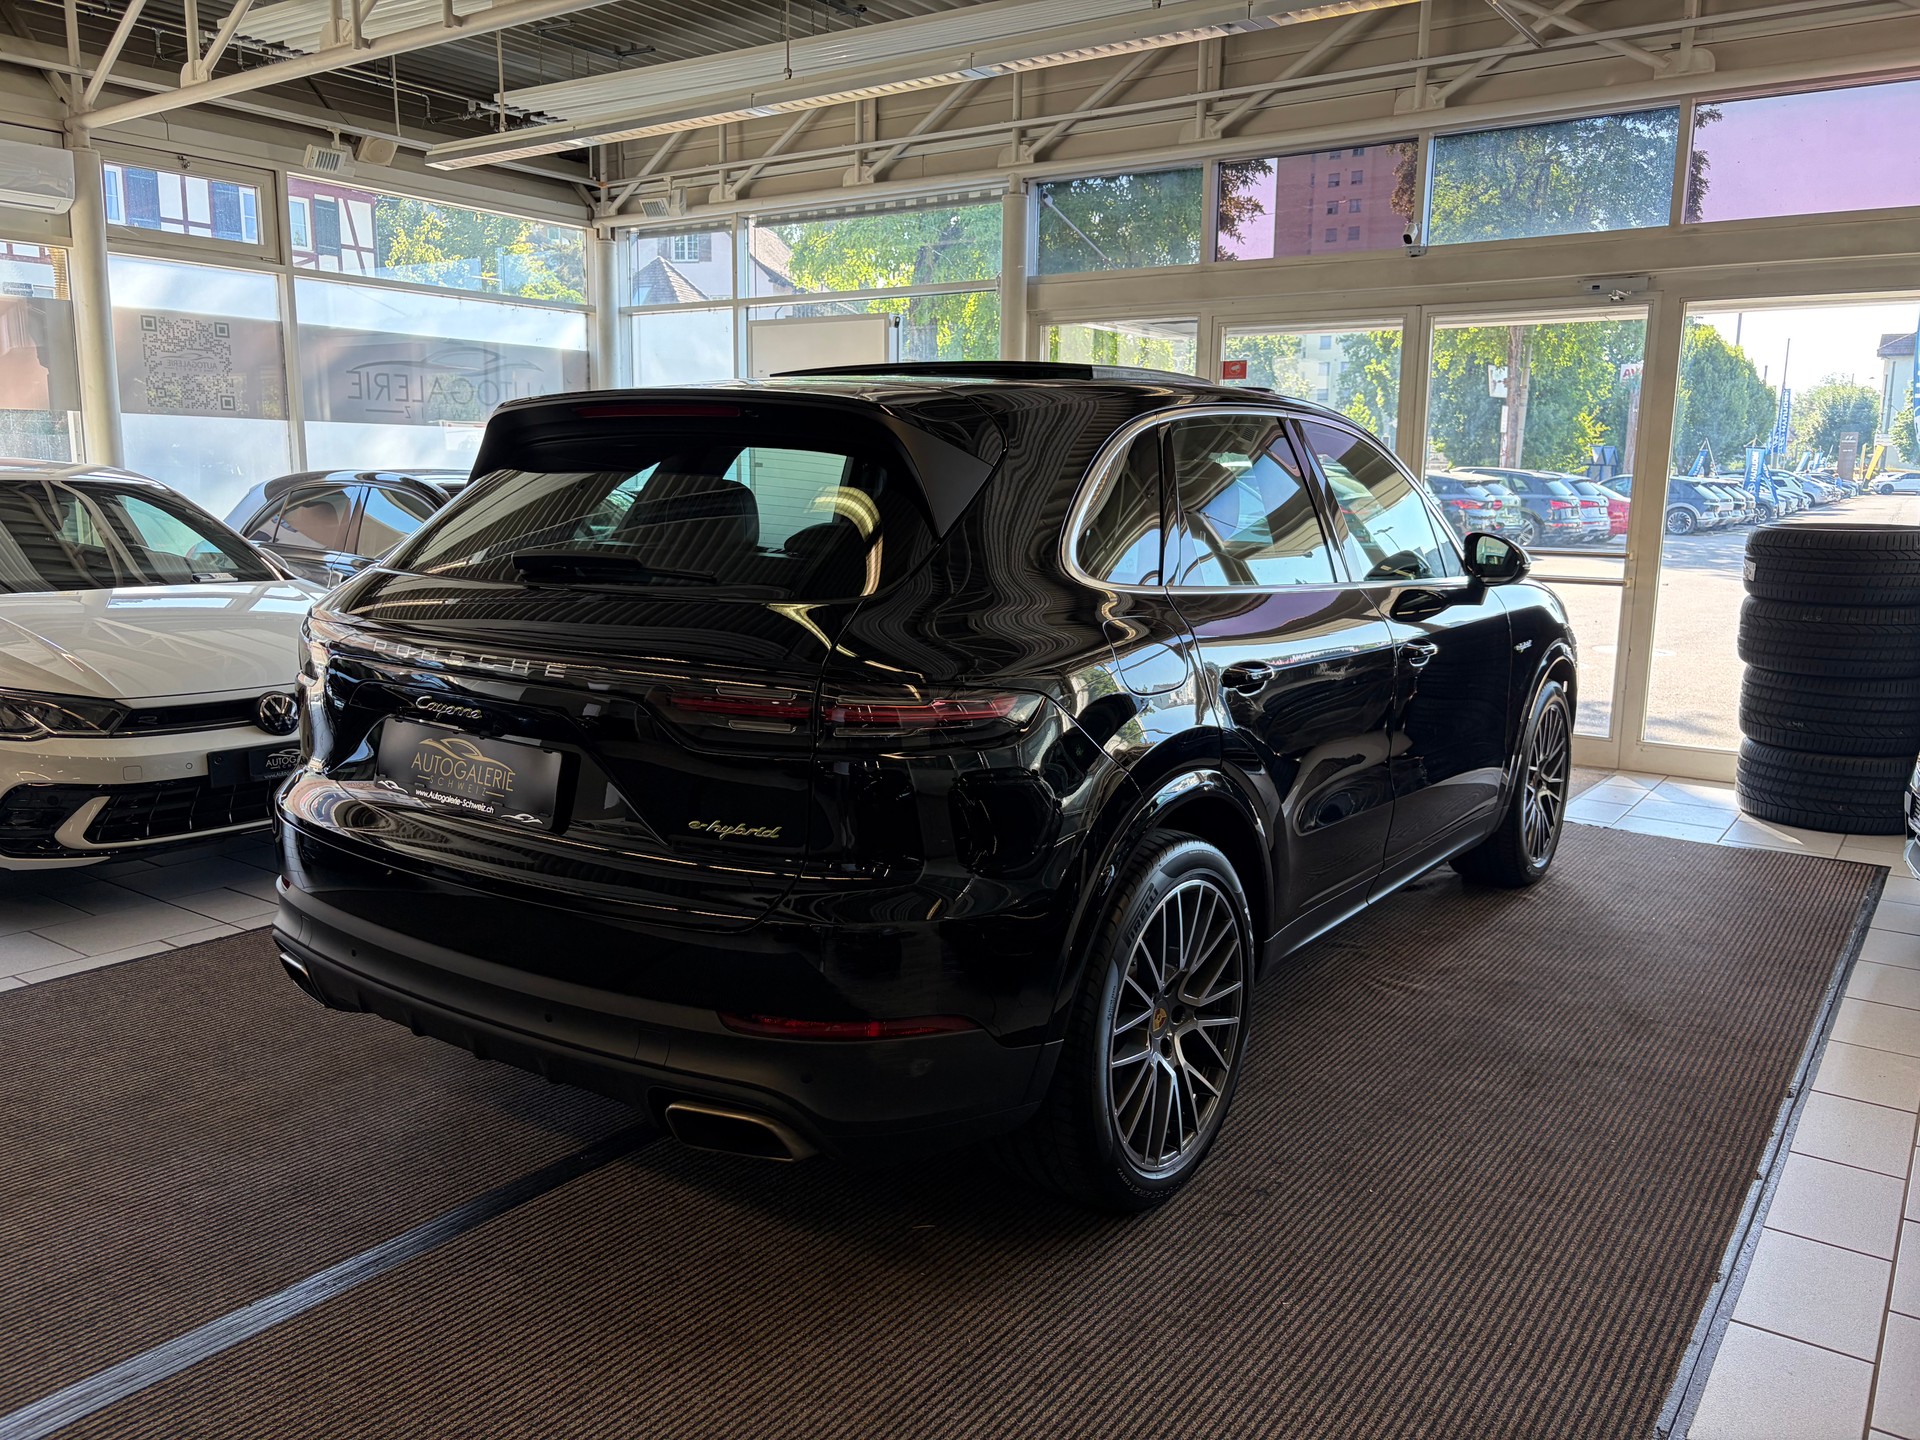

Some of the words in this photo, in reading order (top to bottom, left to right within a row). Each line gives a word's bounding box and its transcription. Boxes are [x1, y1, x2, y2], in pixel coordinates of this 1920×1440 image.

[373, 640, 566, 678] PORSCHE
[416, 695, 482, 719] Cayenne
[411, 752, 516, 792] AUTOGALERIE
[430, 775, 486, 797] SCHWEIZ
[415, 789, 495, 814] www.Autogalerie-Schweiz.ch
[688, 820, 782, 840] e-hybrid
[1123, 882, 1159, 948] PIRELLI
